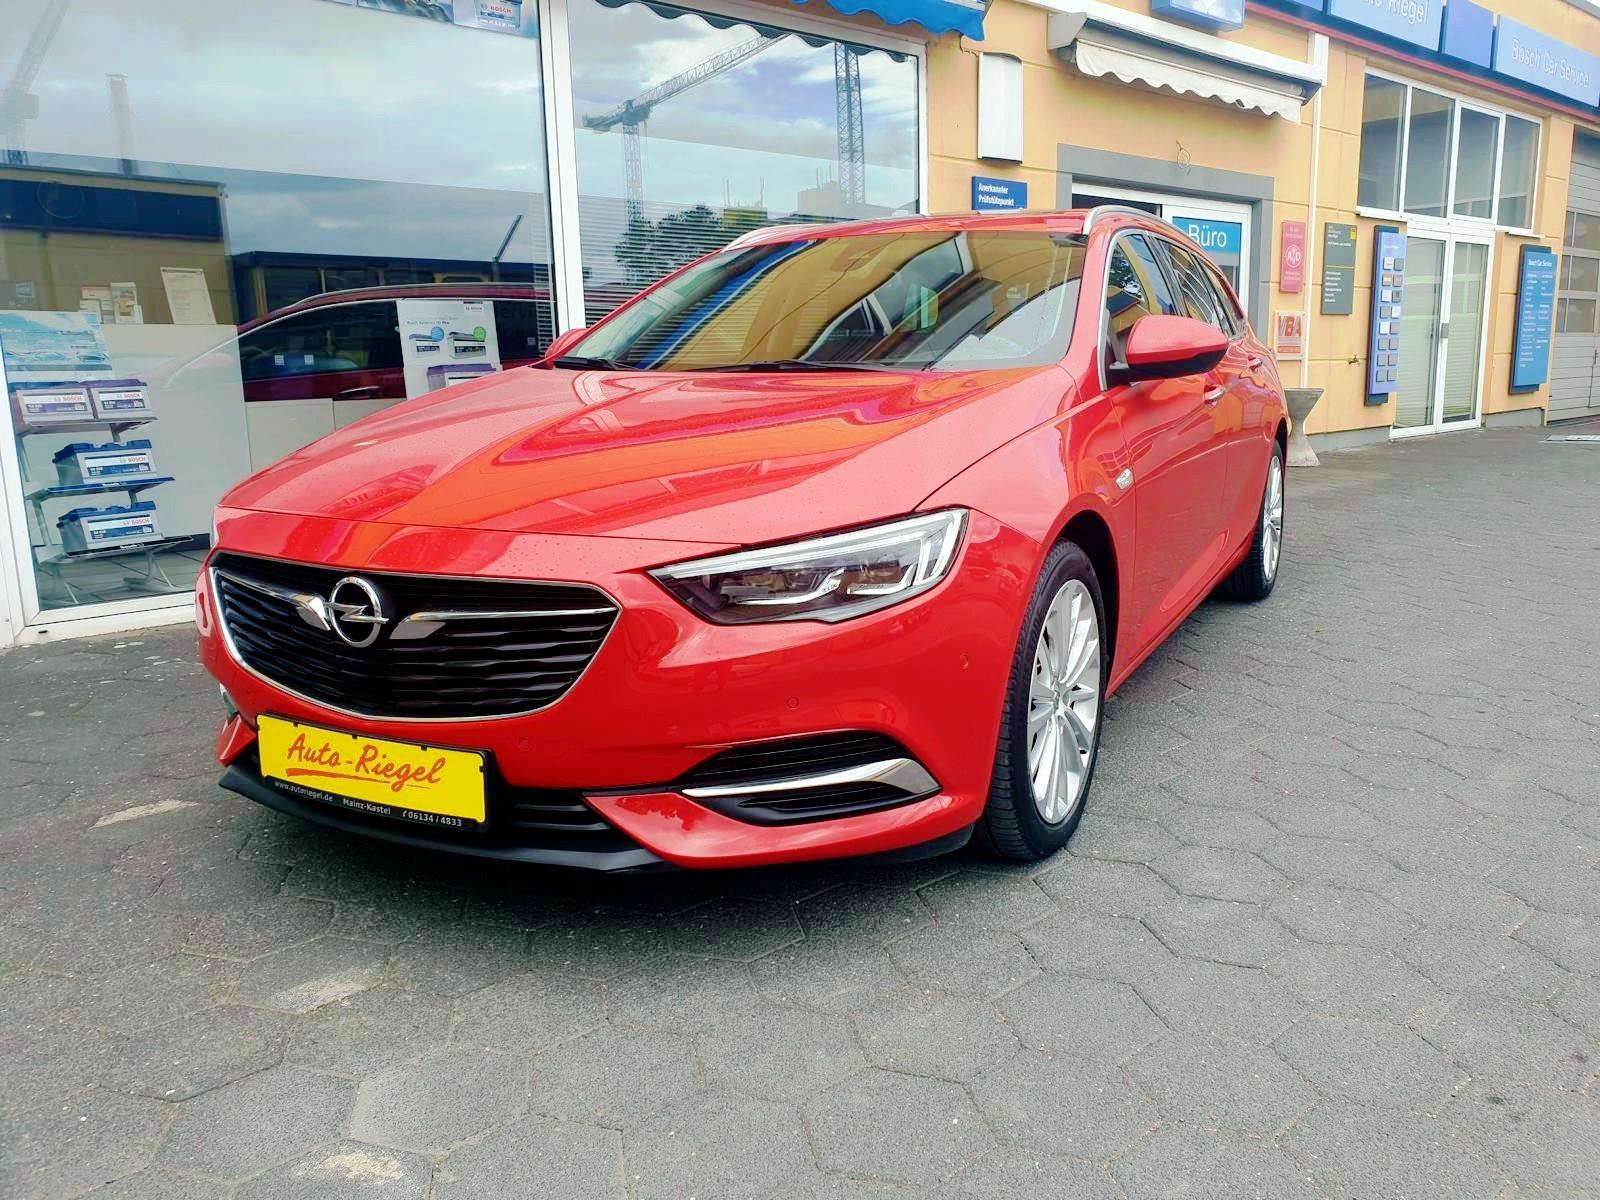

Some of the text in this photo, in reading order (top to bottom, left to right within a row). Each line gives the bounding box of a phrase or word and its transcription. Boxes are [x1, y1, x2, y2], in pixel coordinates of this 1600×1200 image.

[1511, 38, 1591, 88] Bosch Car Service
[978, 183, 1009, 194] Anerkannter
[978, 194, 1015, 207] Prüfstützpunkt
[1188, 224, 1227, 248] Büro
[286, 732, 447, 793] Auto-Riegel
[274, 780, 334, 802] www.autoriegel.de
[342, 798, 392, 816] Mainz-Kastel
[440, 816, 463, 828] 4833
